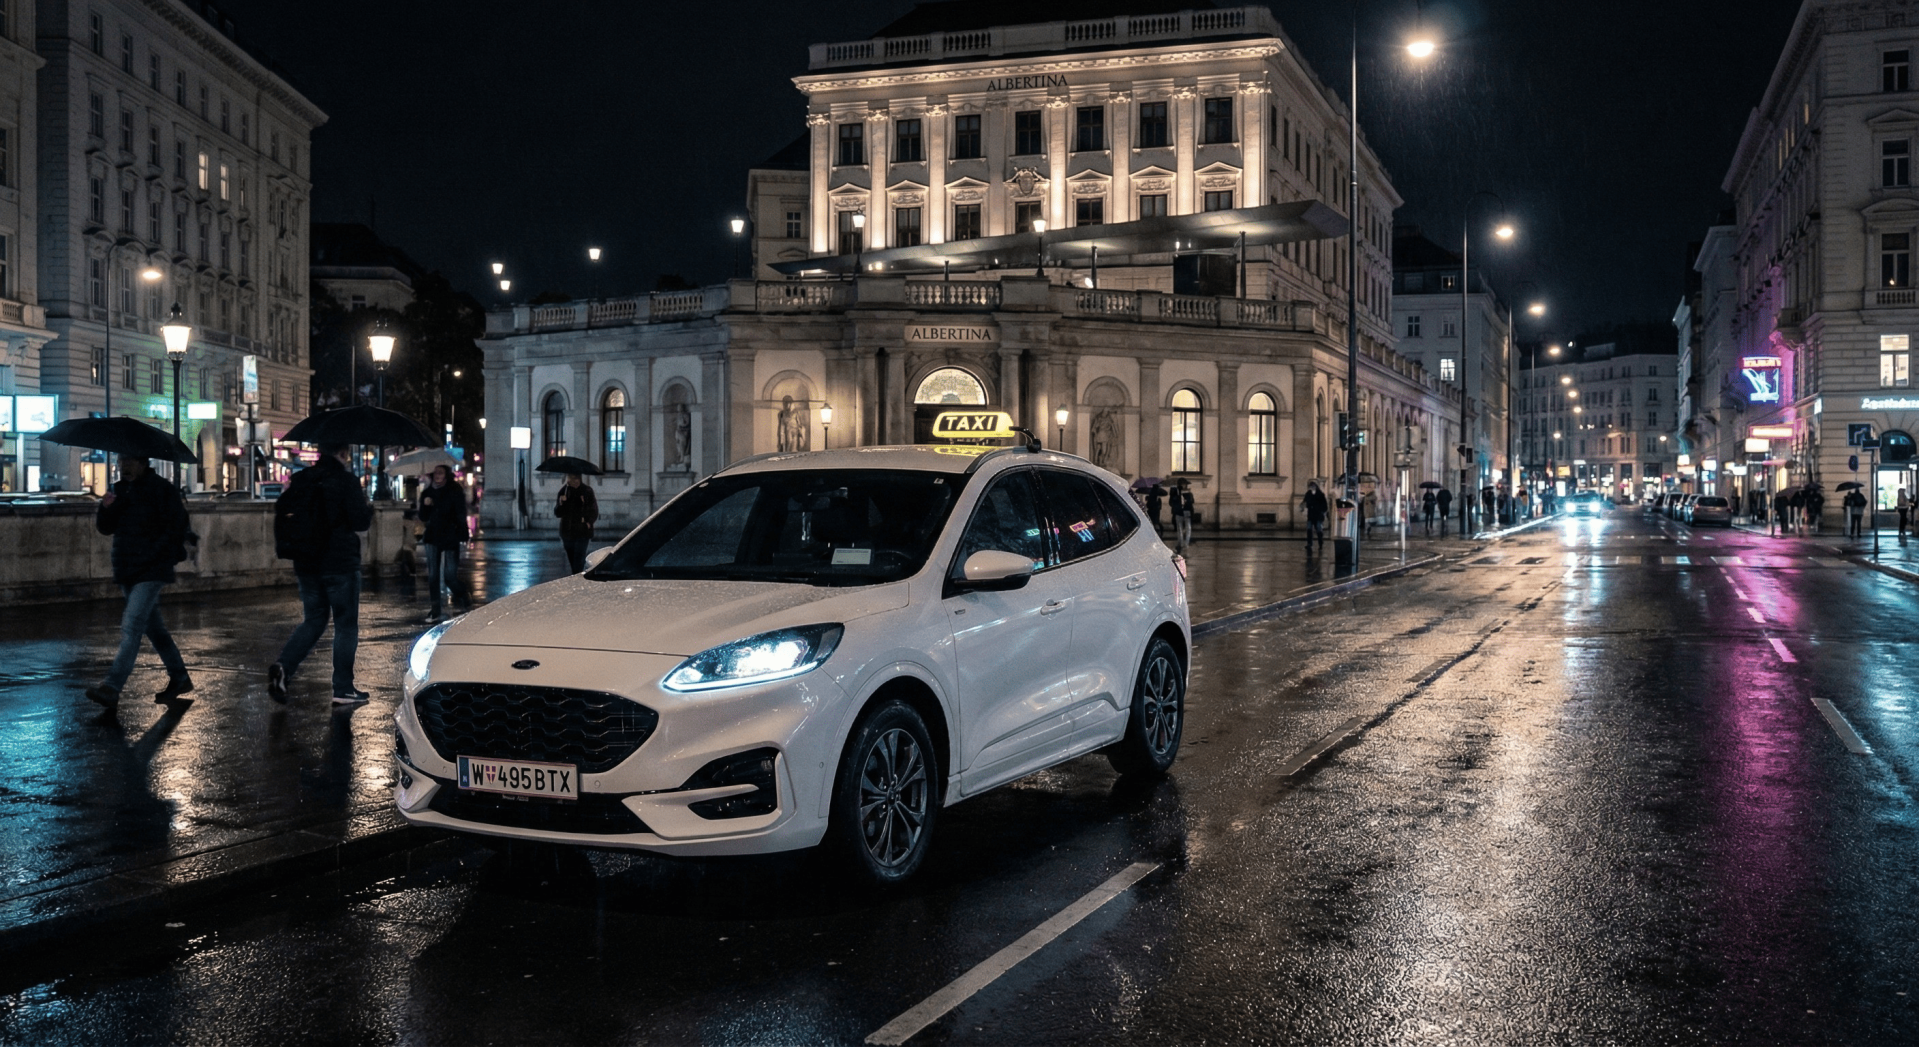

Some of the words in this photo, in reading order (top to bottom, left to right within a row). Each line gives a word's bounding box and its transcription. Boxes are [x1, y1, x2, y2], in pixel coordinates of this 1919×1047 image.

[987, 74, 1068, 91] ALBERTINA
[912, 327, 991, 340] ALBERTINA
[946, 416, 994, 430] TAXI
